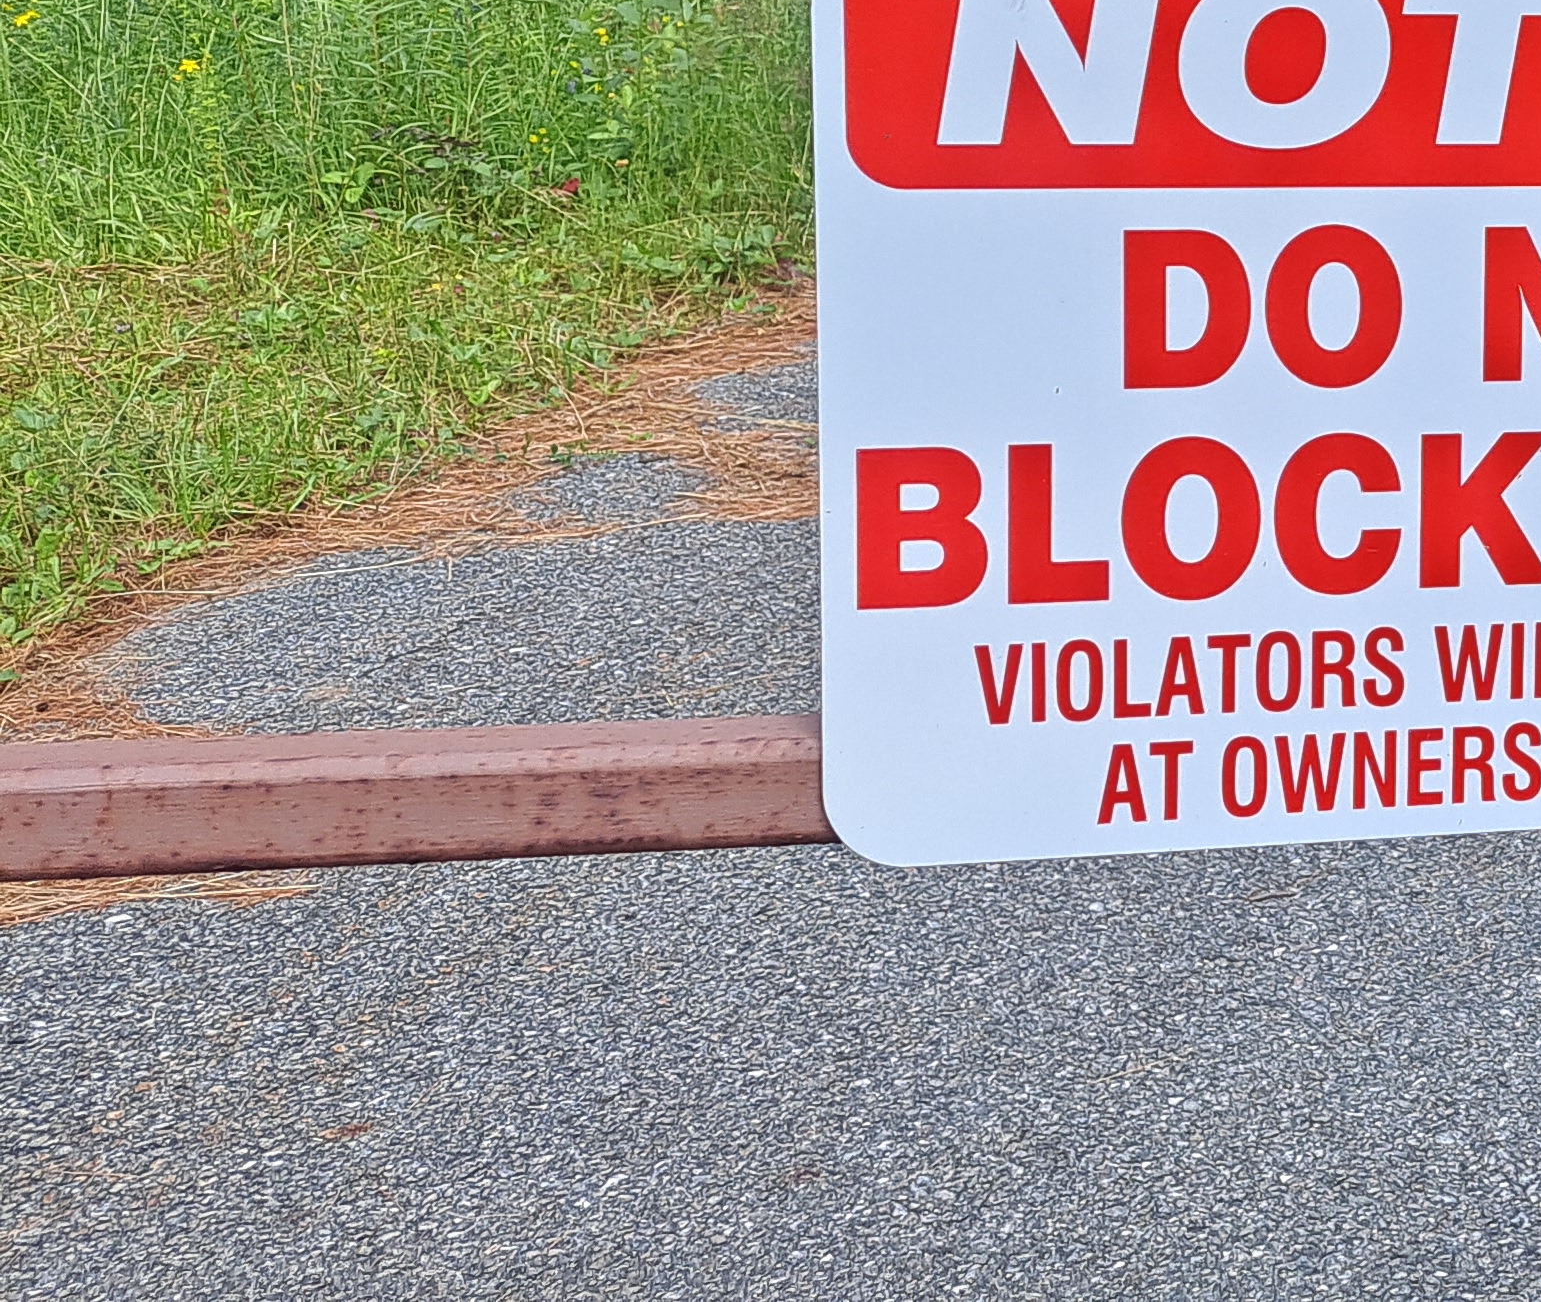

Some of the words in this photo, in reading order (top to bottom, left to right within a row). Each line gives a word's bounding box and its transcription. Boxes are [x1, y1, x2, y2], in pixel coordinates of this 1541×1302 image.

[1124, 224, 1403, 389] DO
[975, 627, 1405, 725] VIOLATORS
[1098, 741, 1194, 825] AT
